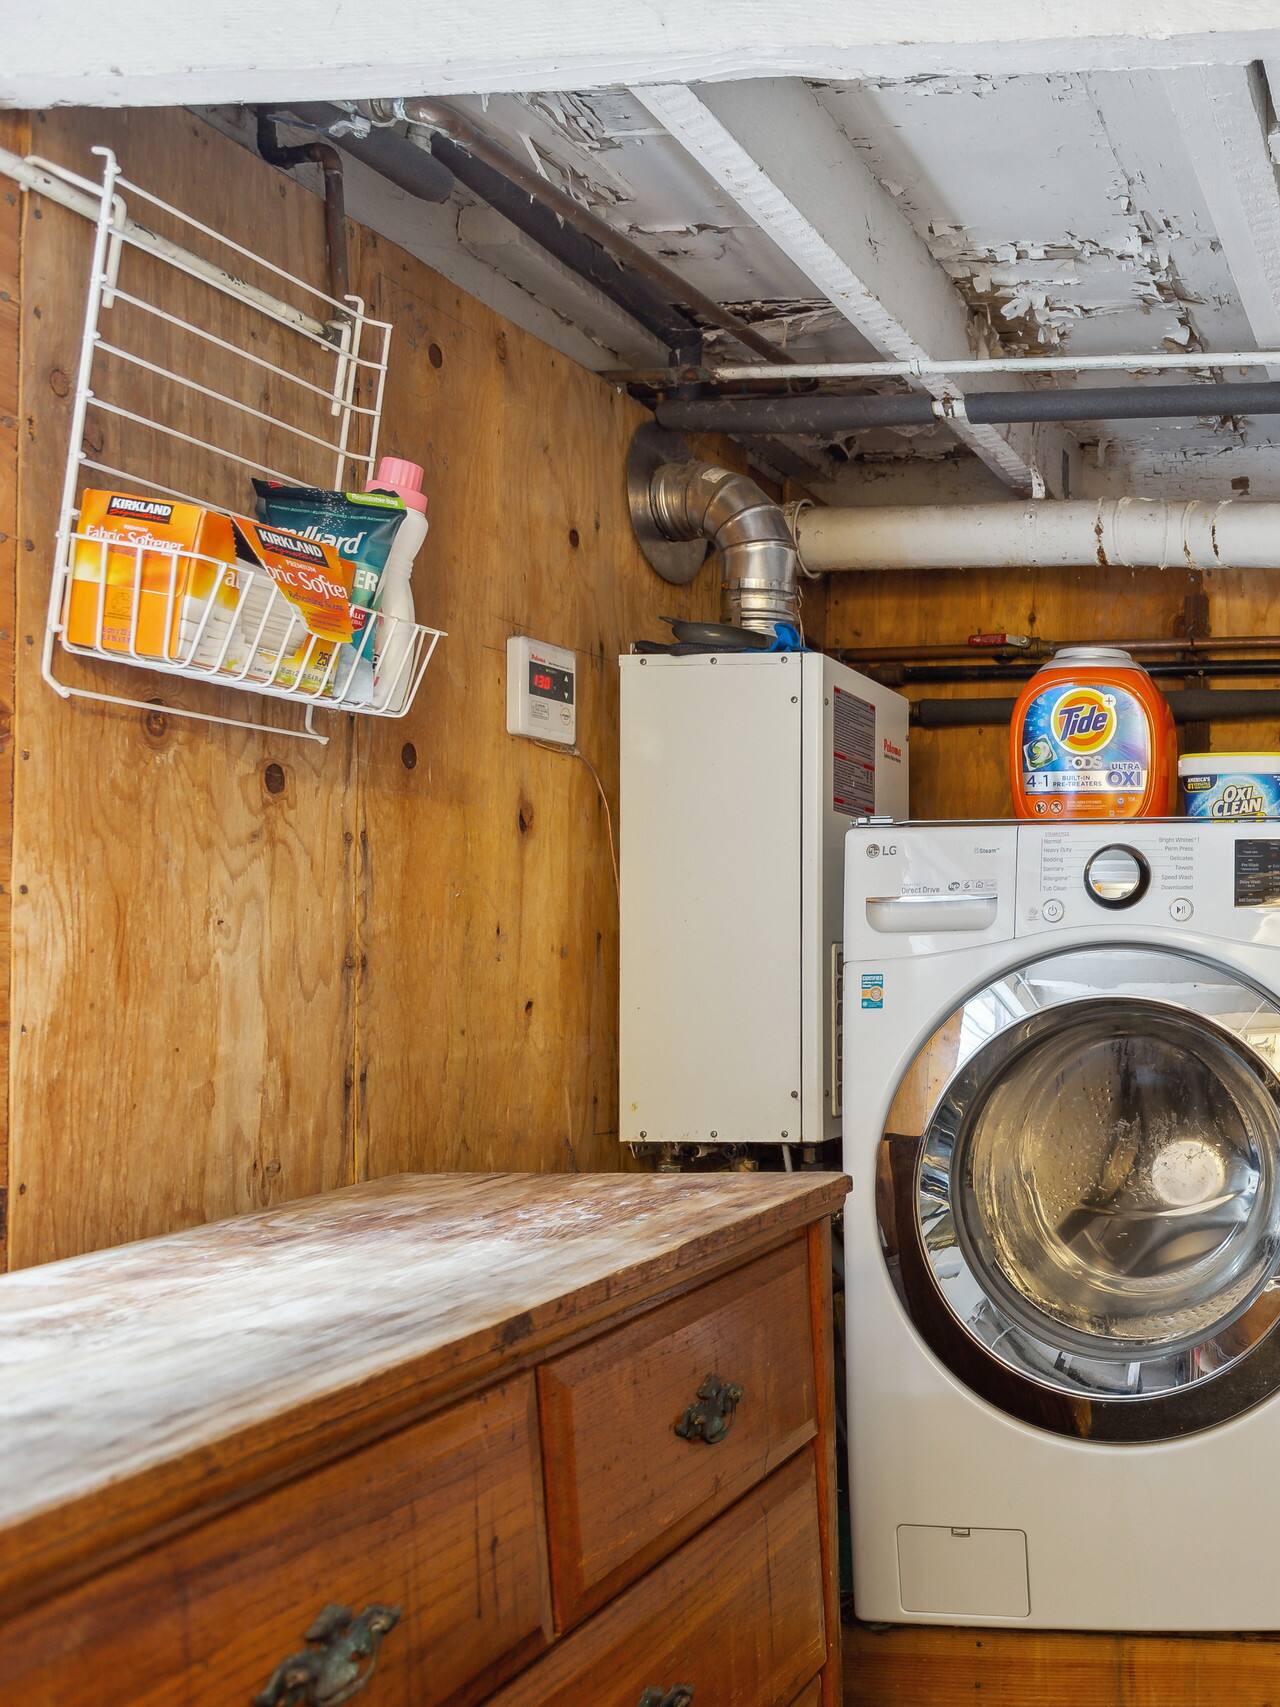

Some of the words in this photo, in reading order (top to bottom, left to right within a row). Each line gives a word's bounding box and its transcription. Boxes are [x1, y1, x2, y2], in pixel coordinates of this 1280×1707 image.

[111, 497, 172, 517] KIRKLAND
[258, 529, 323, 558] KIRKLAND
[286, 560, 317, 573] PREMIUM
[1059, 705, 1108, 741] Tide
[1064, 755, 1103, 770] PODS
[1111, 762, 1140, 770] ULTRA
[1106, 771, 1141, 787] OXI
[1223, 785, 1254, 803] OXI
[1212, 796, 1263, 817] CLEAN
[882, 845, 897, 856] LG
[901, 886, 922, 894] Direct
[922, 886, 940, 894] Drive
